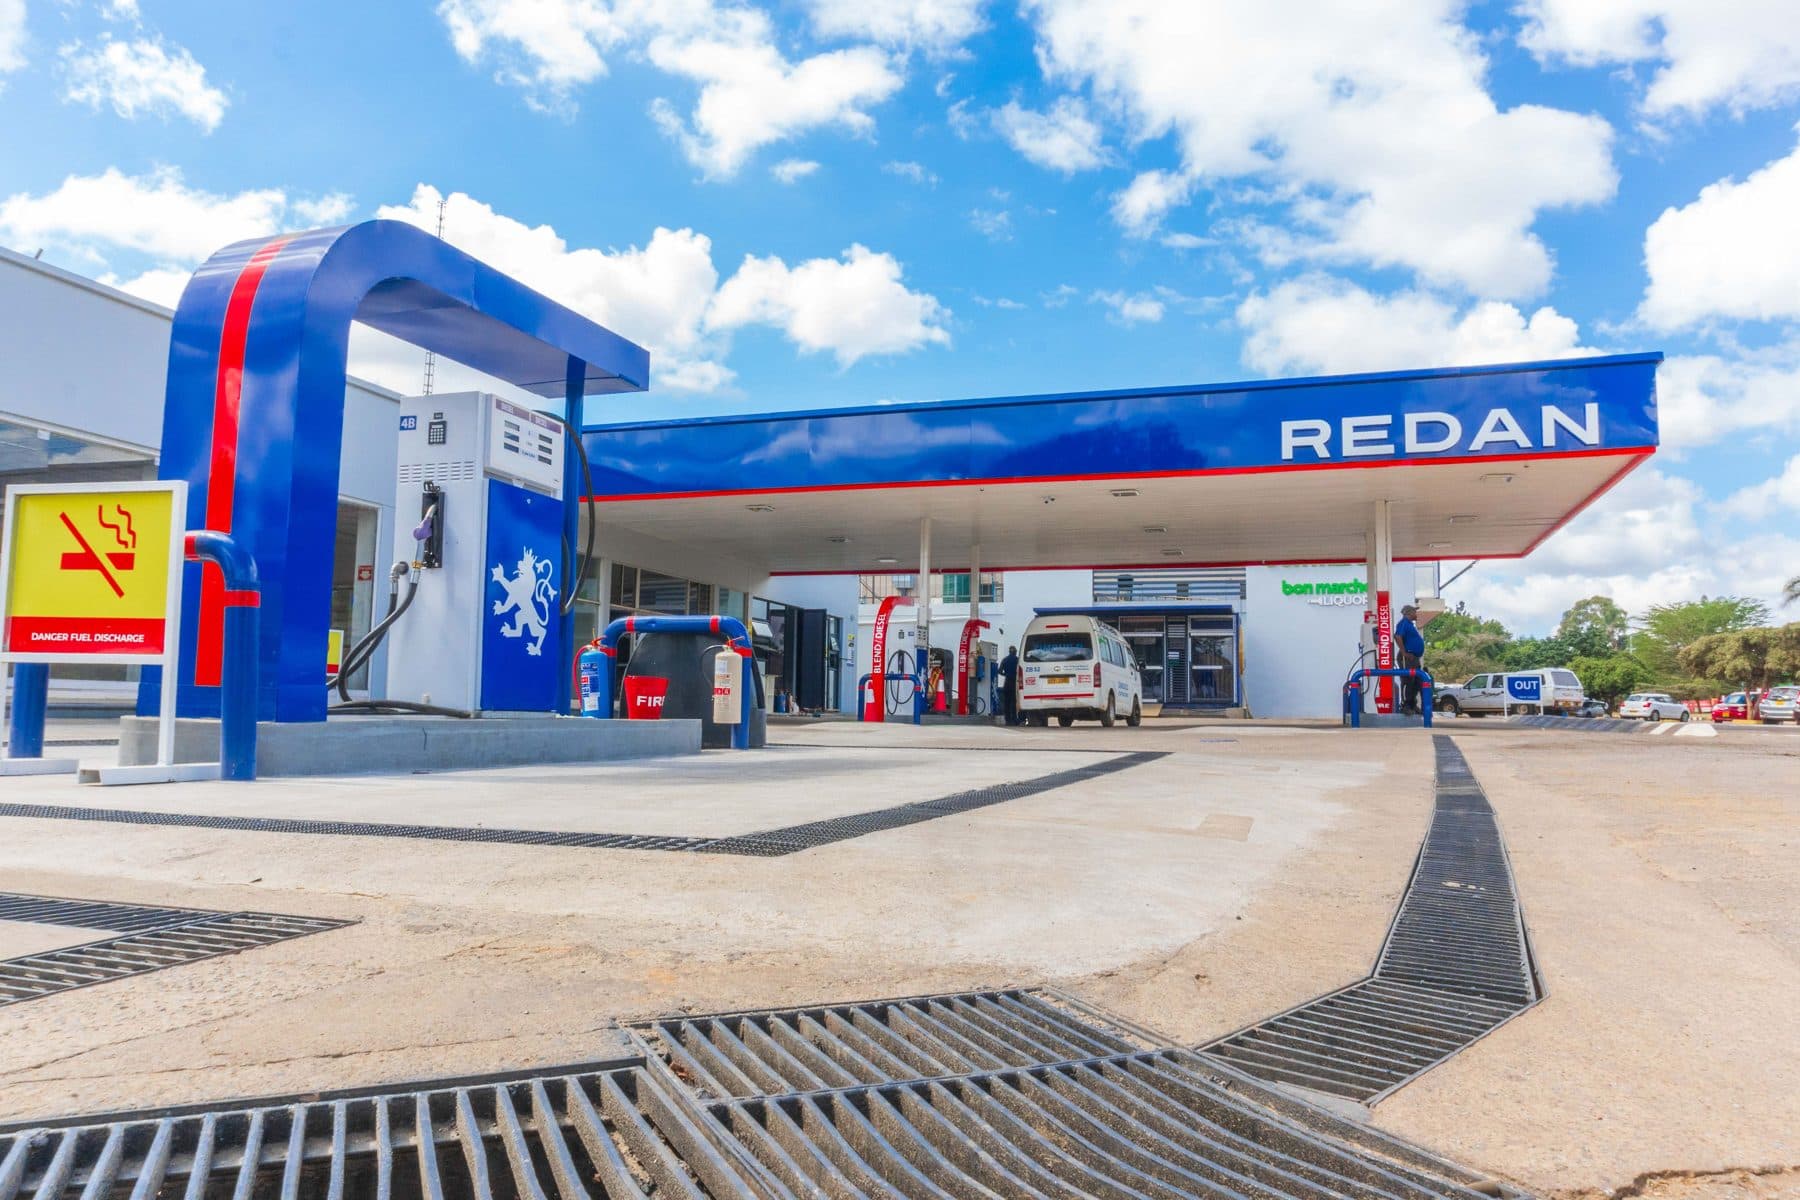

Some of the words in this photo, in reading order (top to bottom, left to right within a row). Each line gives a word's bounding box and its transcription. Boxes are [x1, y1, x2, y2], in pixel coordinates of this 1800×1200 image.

[400, 417, 415, 429] 4B
[1281, 402, 1599, 460] REDAN
[1282, 579, 1313, 595] bon
[875, 613, 887, 639] DIESEL
[1379, 604, 1389, 628] DIESEL
[31, 632, 70, 641] DANGER
[70, 633, 92, 642] FUEL
[94, 634, 144, 643] DISCHARGE
[873, 644, 882, 674] BLEND
[1380, 634, 1390, 665] BLEND
[1514, 681, 1539, 690] OUT
[636, 695, 666, 707] FIR
